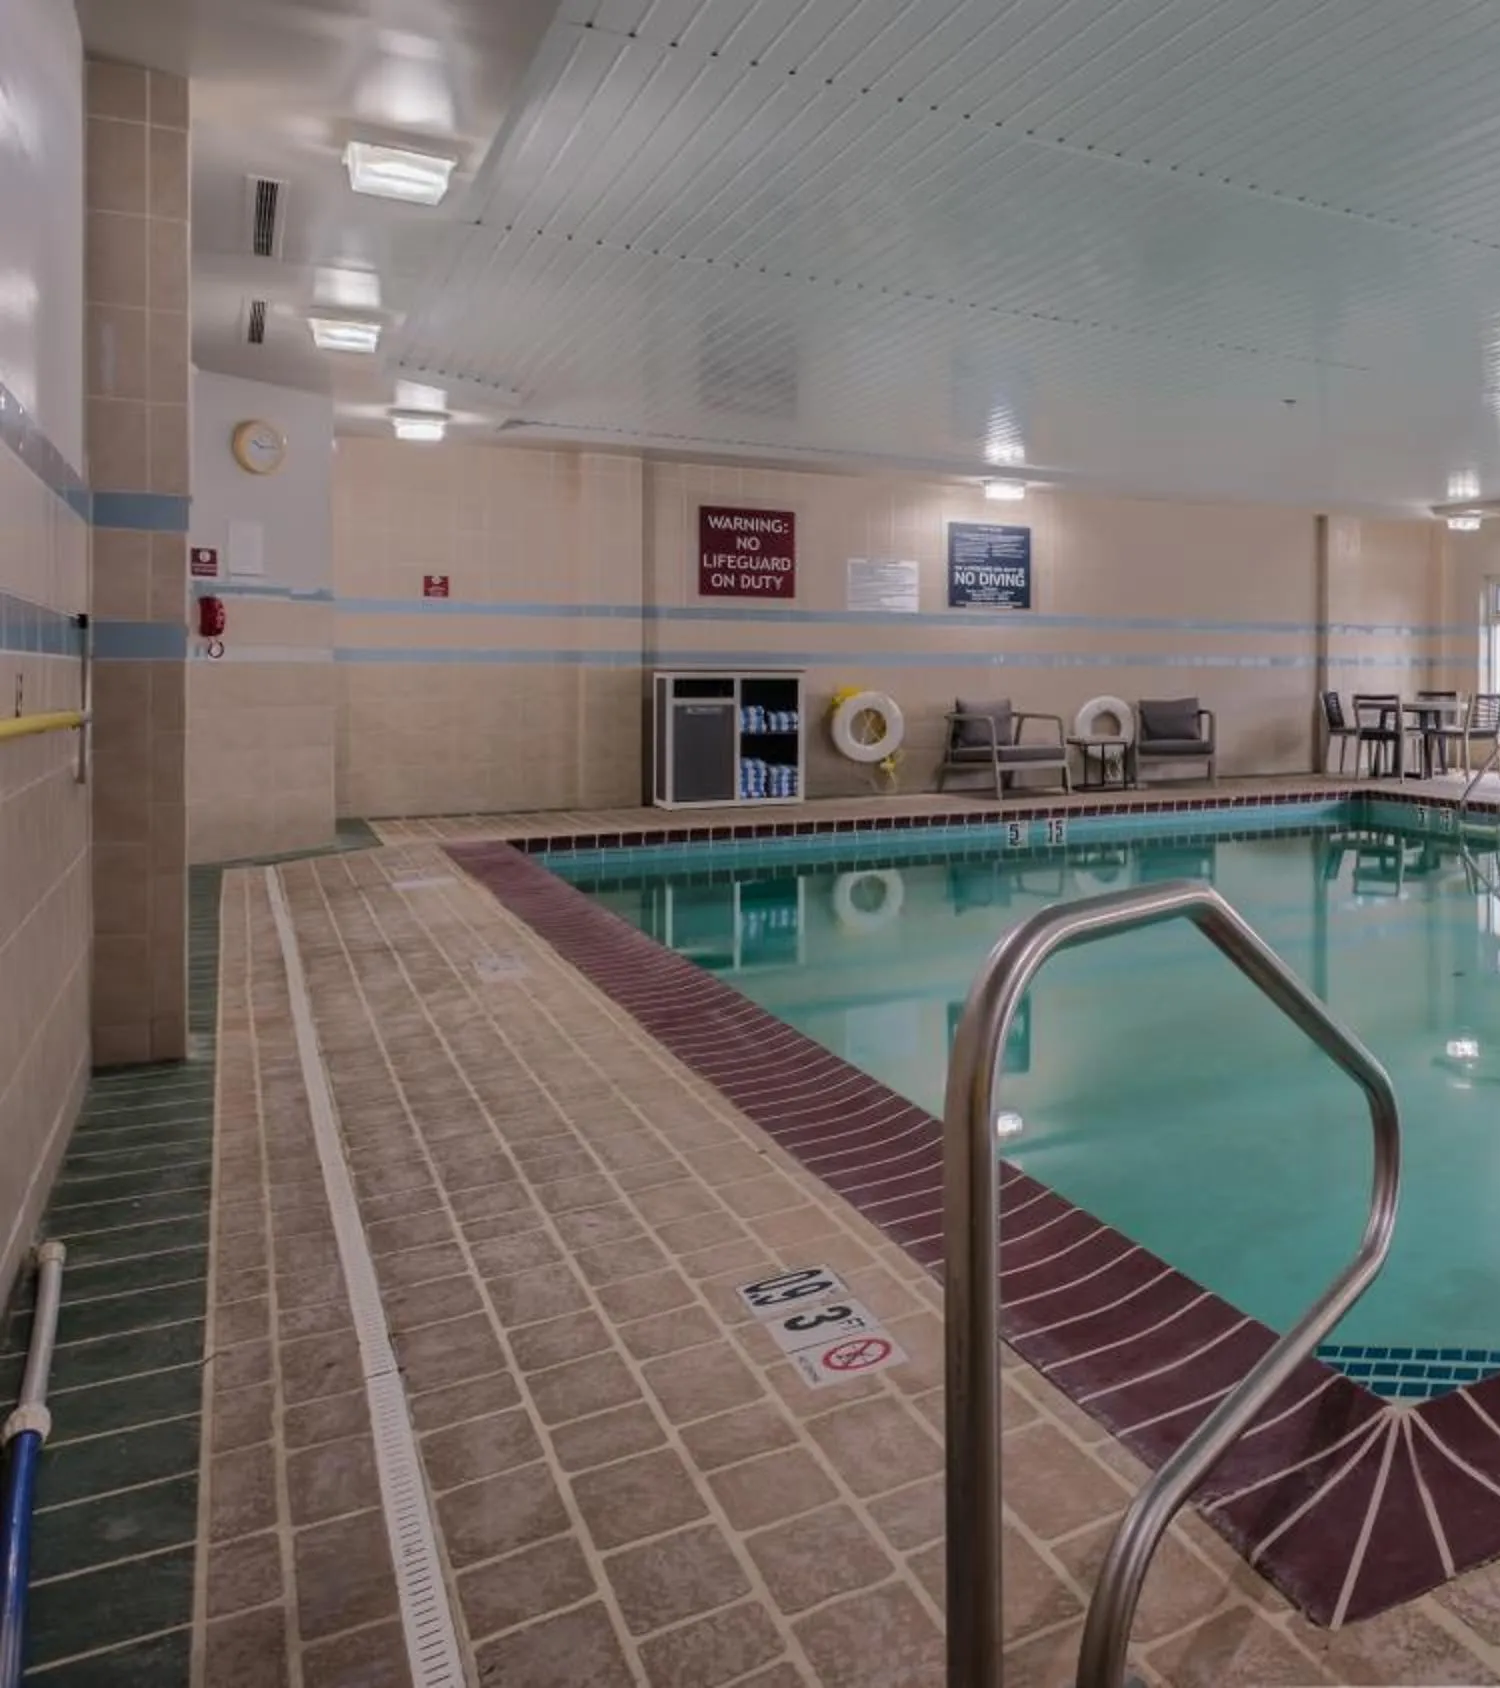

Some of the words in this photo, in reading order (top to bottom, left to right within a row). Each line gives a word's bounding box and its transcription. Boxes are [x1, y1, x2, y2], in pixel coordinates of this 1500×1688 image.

[708, 515, 789, 533] WARNING:
[736, 537, 761, 551] NO
[703, 554, 791, 570] LIFEGUARD
[711, 573, 735, 587] ON
[741, 575, 783, 590] DUTY
[954, 571, 975, 586] NO
[979, 571, 1025, 587] DIVING
[783, 1306, 852, 1331] 3
